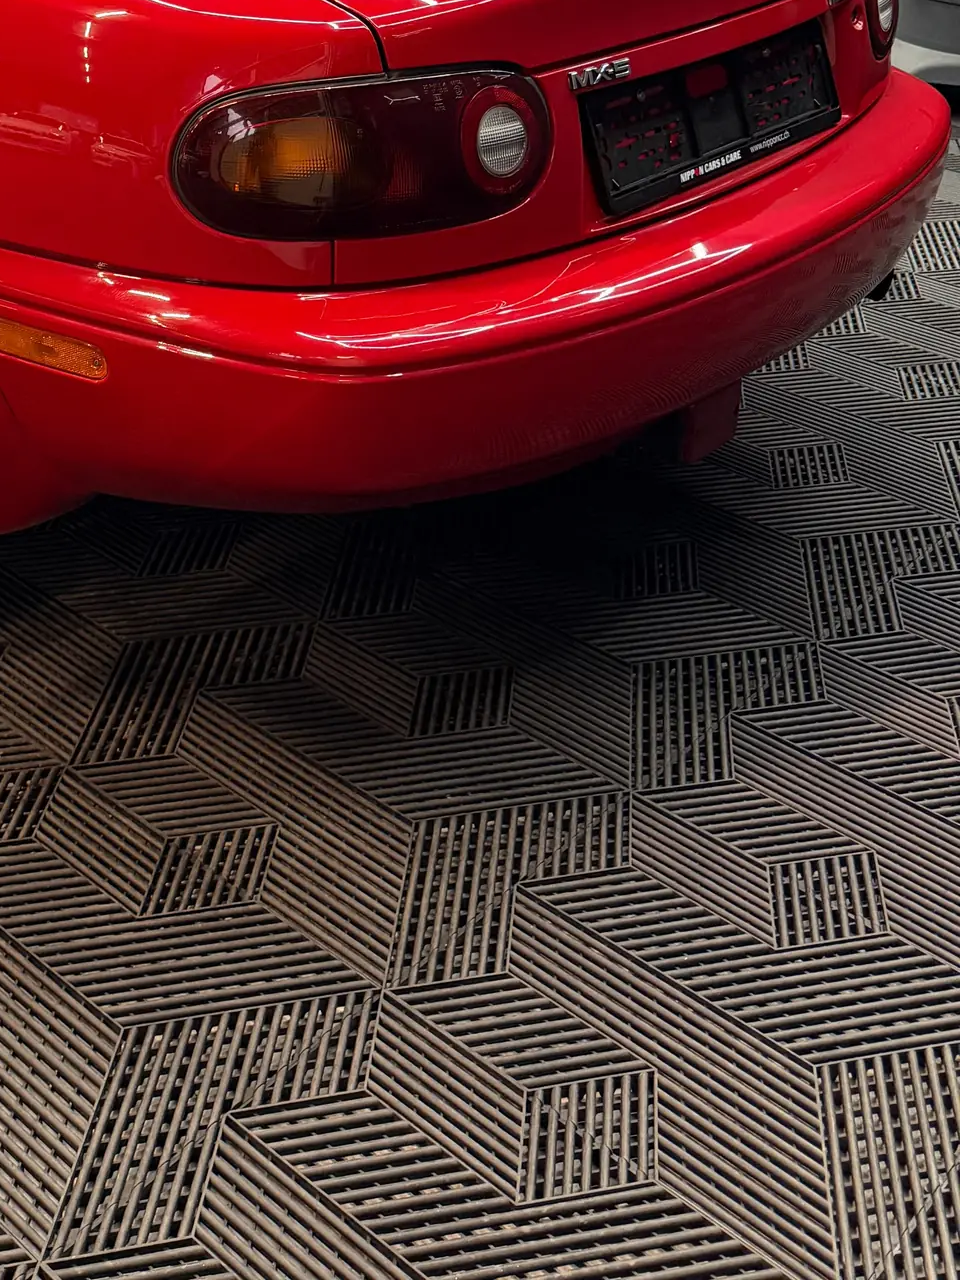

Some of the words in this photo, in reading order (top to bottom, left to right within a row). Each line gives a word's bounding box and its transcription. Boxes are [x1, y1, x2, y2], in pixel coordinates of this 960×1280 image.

[568, 57, 631, 90] MX-5
[704, 158, 721, 173] CARS
[725, 149, 742, 164] CARE
